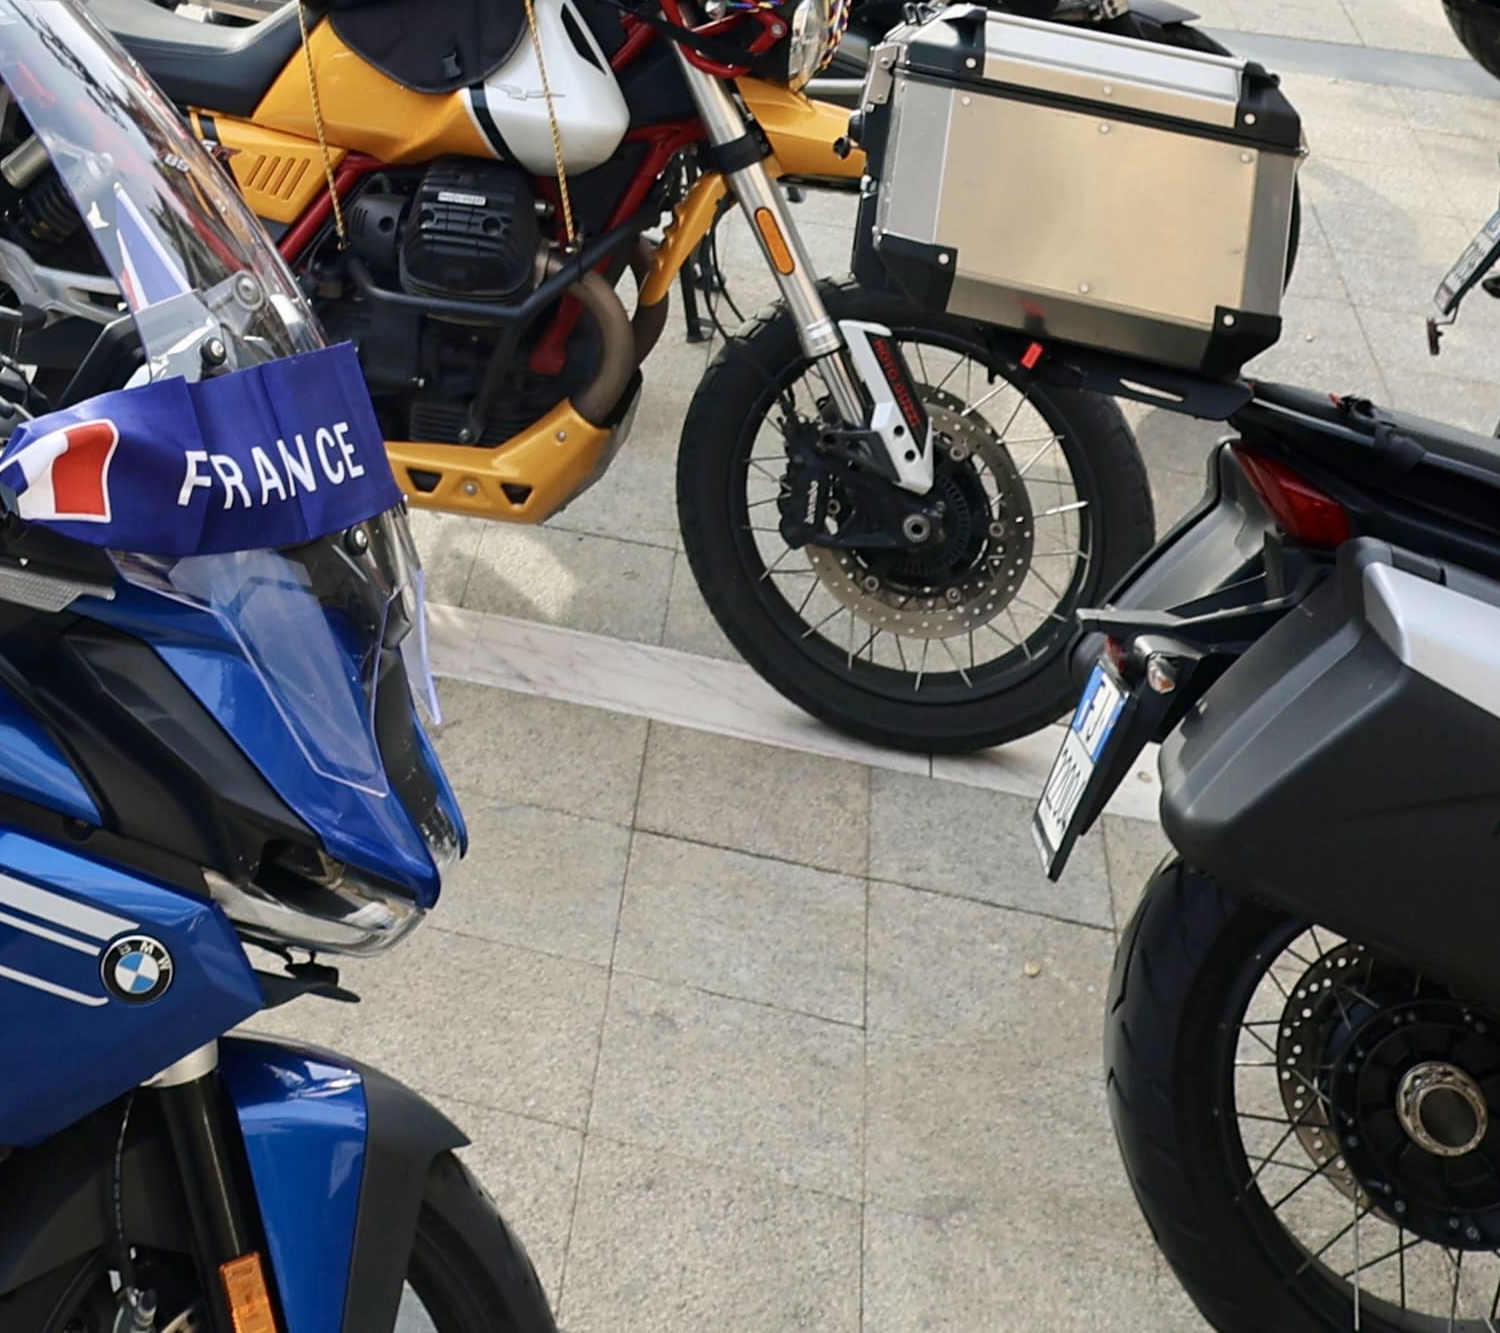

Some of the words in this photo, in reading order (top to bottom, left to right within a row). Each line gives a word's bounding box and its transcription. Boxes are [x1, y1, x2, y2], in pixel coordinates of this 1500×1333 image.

[873, 338, 898, 382] MOTO
[893, 380, 921, 429] GUZZI
[177, 420, 365, 511] FRANCE
